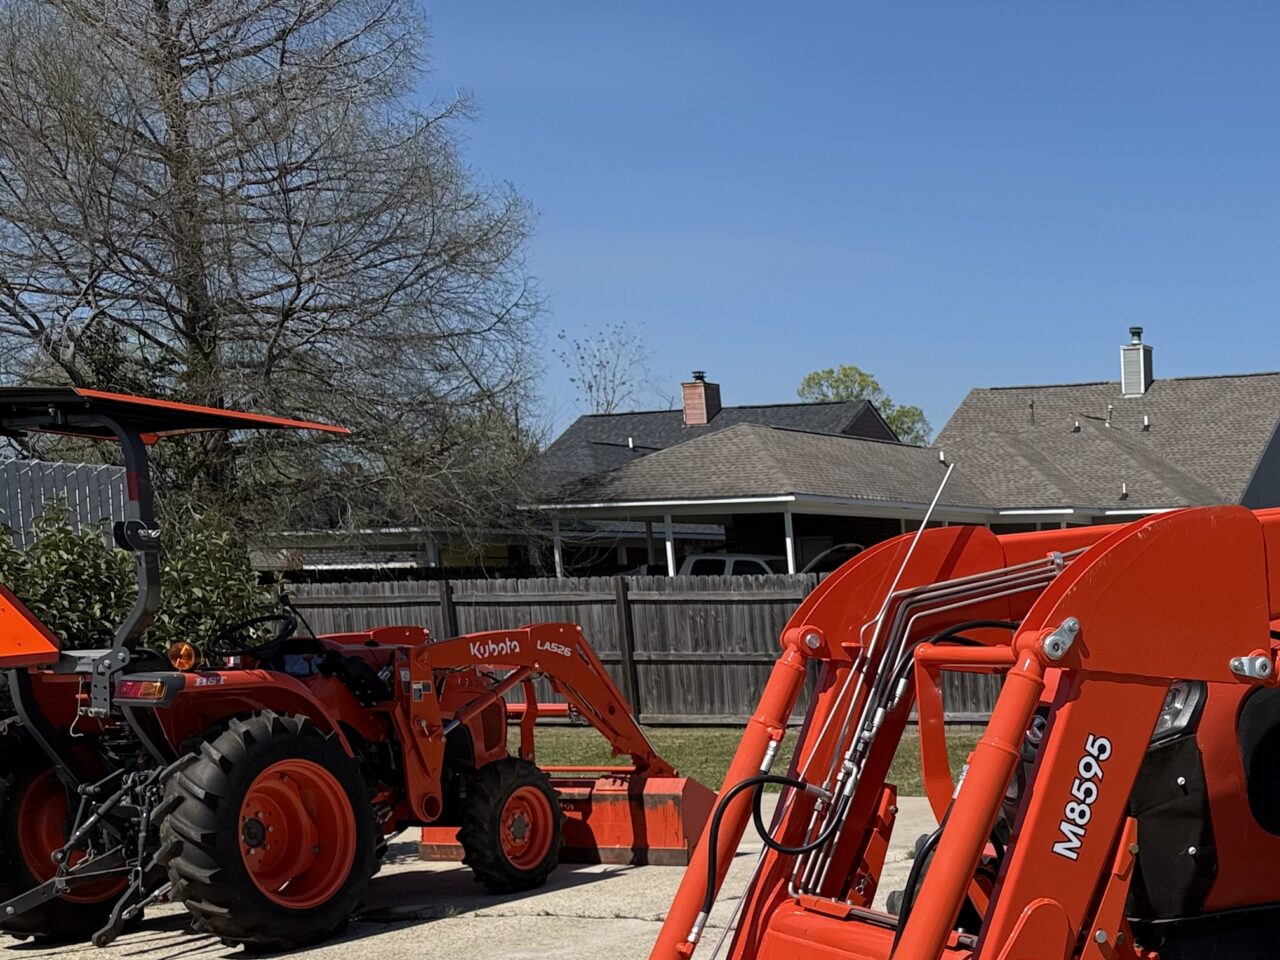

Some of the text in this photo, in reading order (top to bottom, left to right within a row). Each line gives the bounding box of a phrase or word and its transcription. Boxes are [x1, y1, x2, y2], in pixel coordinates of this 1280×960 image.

[469, 637, 521, 659] Kubota
[536, 640, 573, 657] LA526
[1052, 732, 1112, 861] M8595
